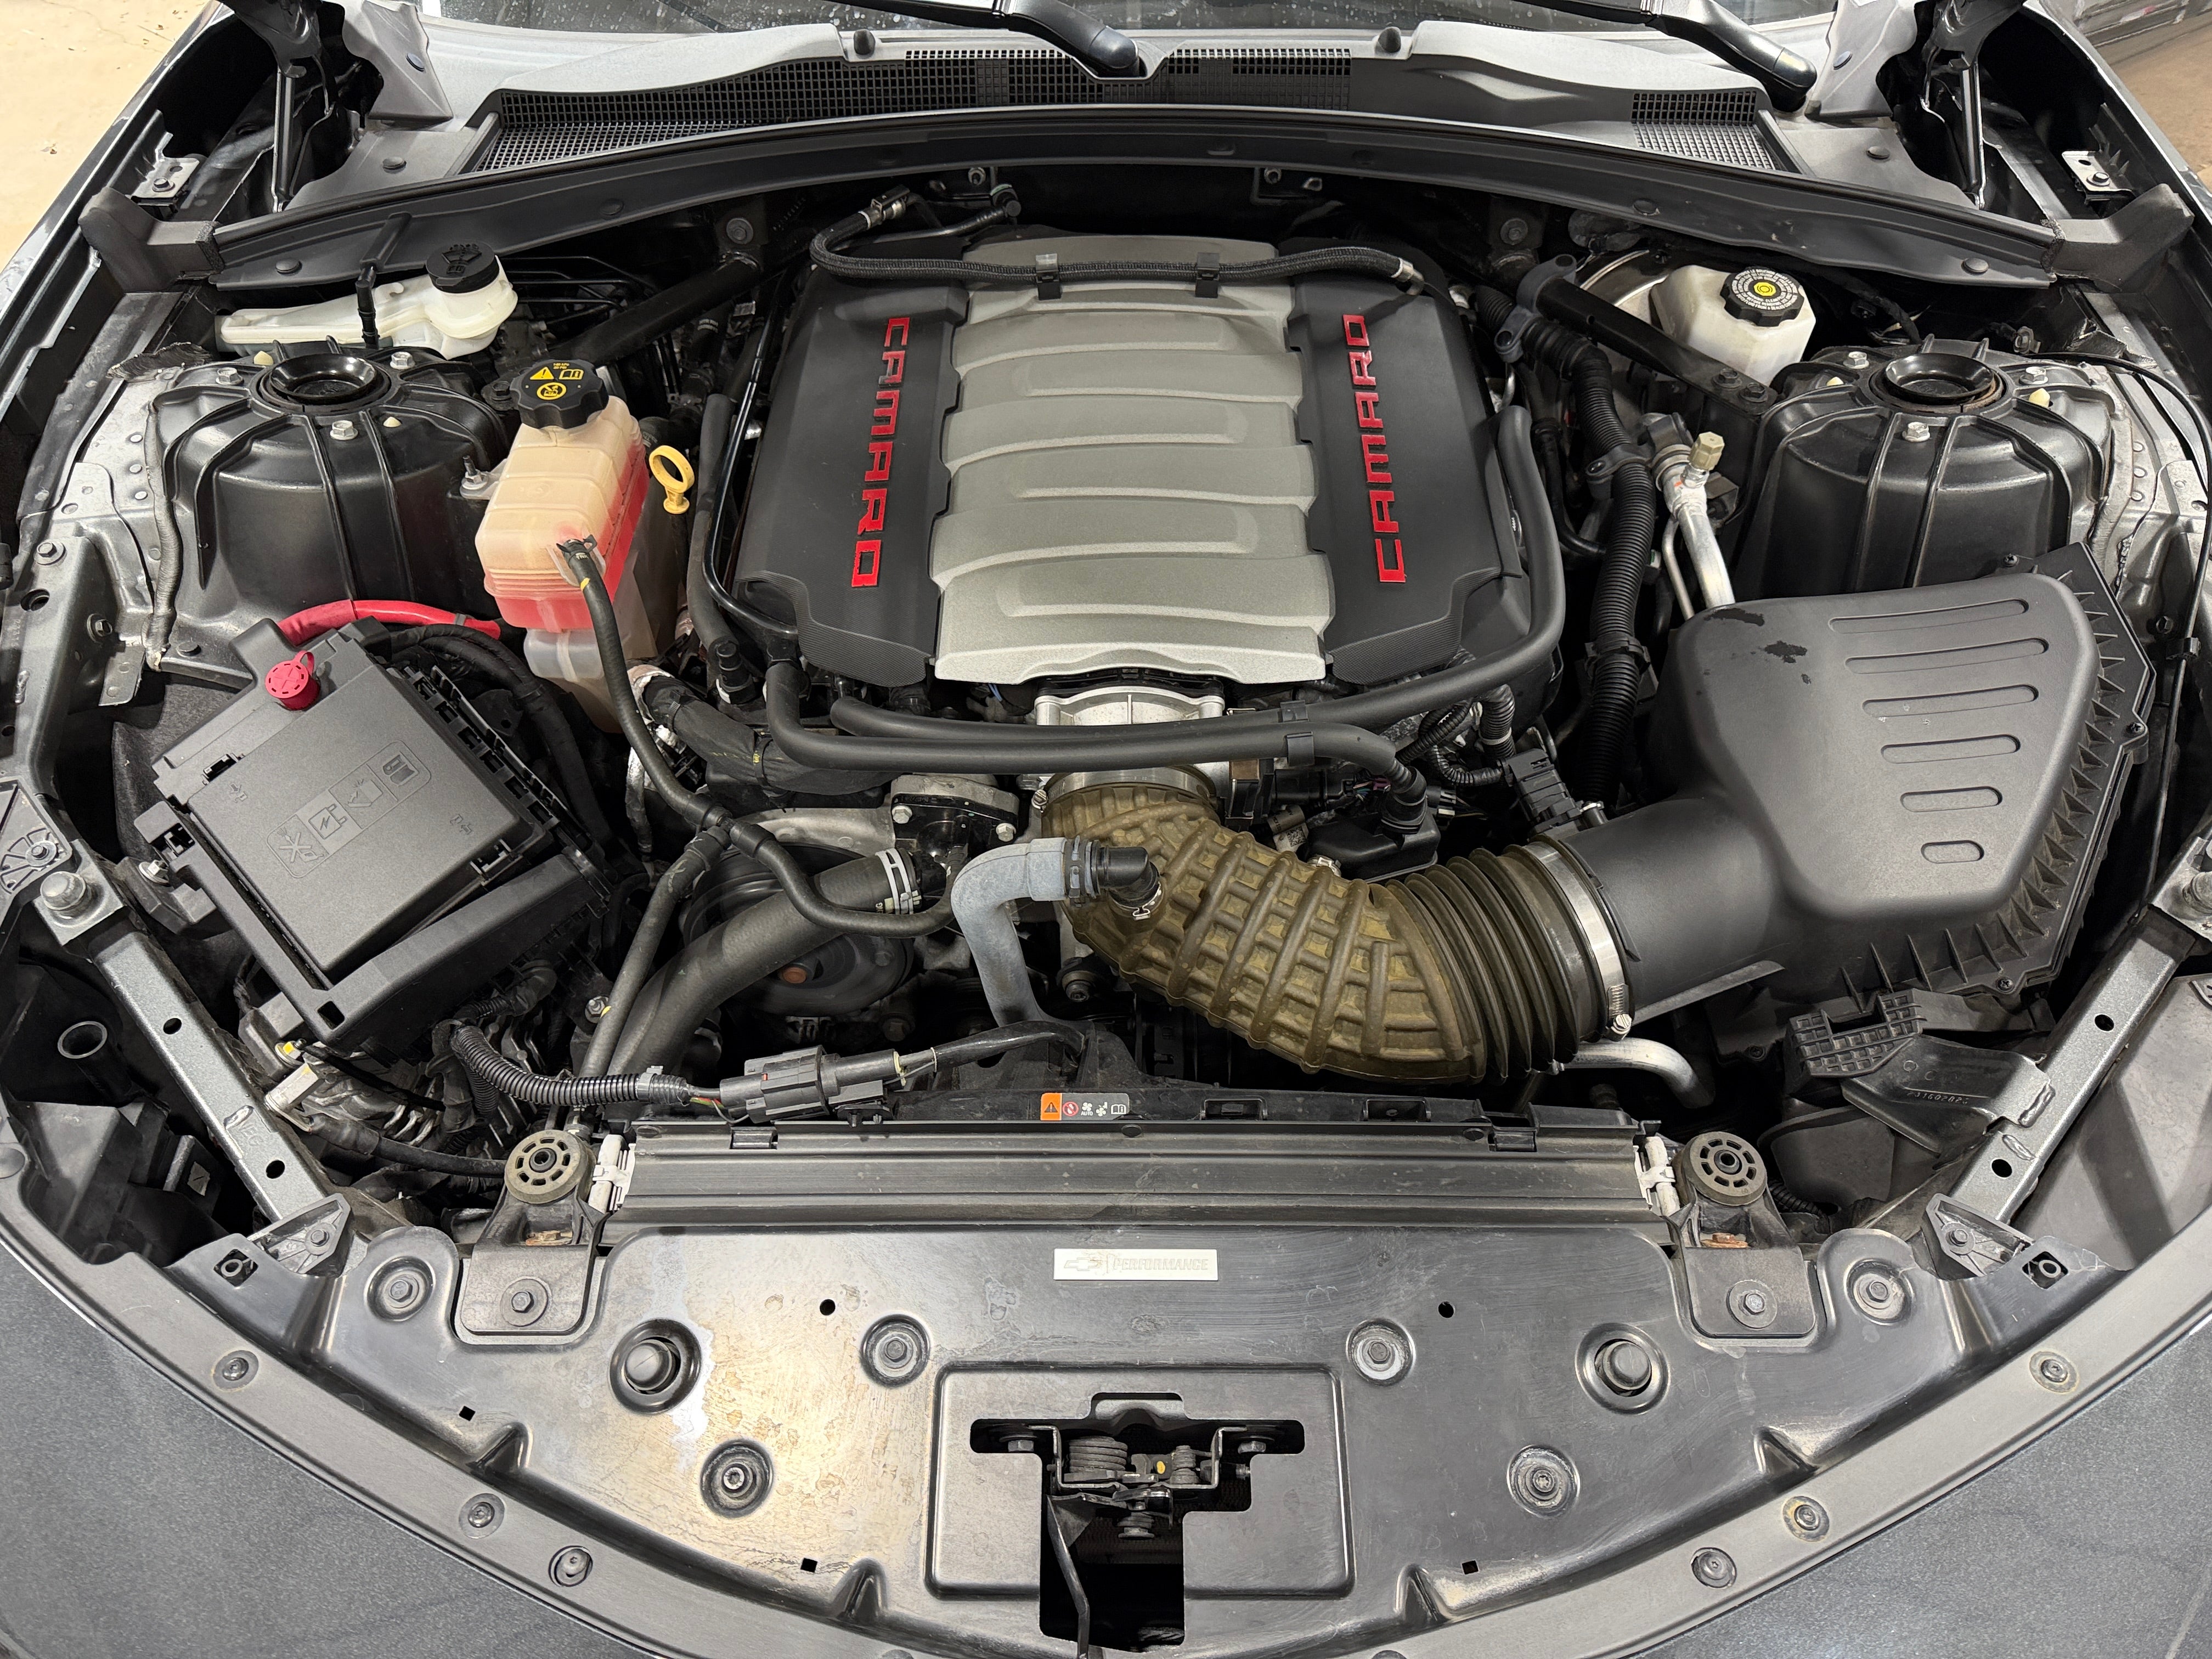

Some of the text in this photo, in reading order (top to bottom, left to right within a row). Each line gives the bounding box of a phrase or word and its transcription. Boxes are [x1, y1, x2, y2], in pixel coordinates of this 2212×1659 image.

[851, 317, 910, 587] CAMARO
[1342, 314, 1406, 583] CAMARO
[1113, 1258, 1209, 1271] PERFORMANCE
